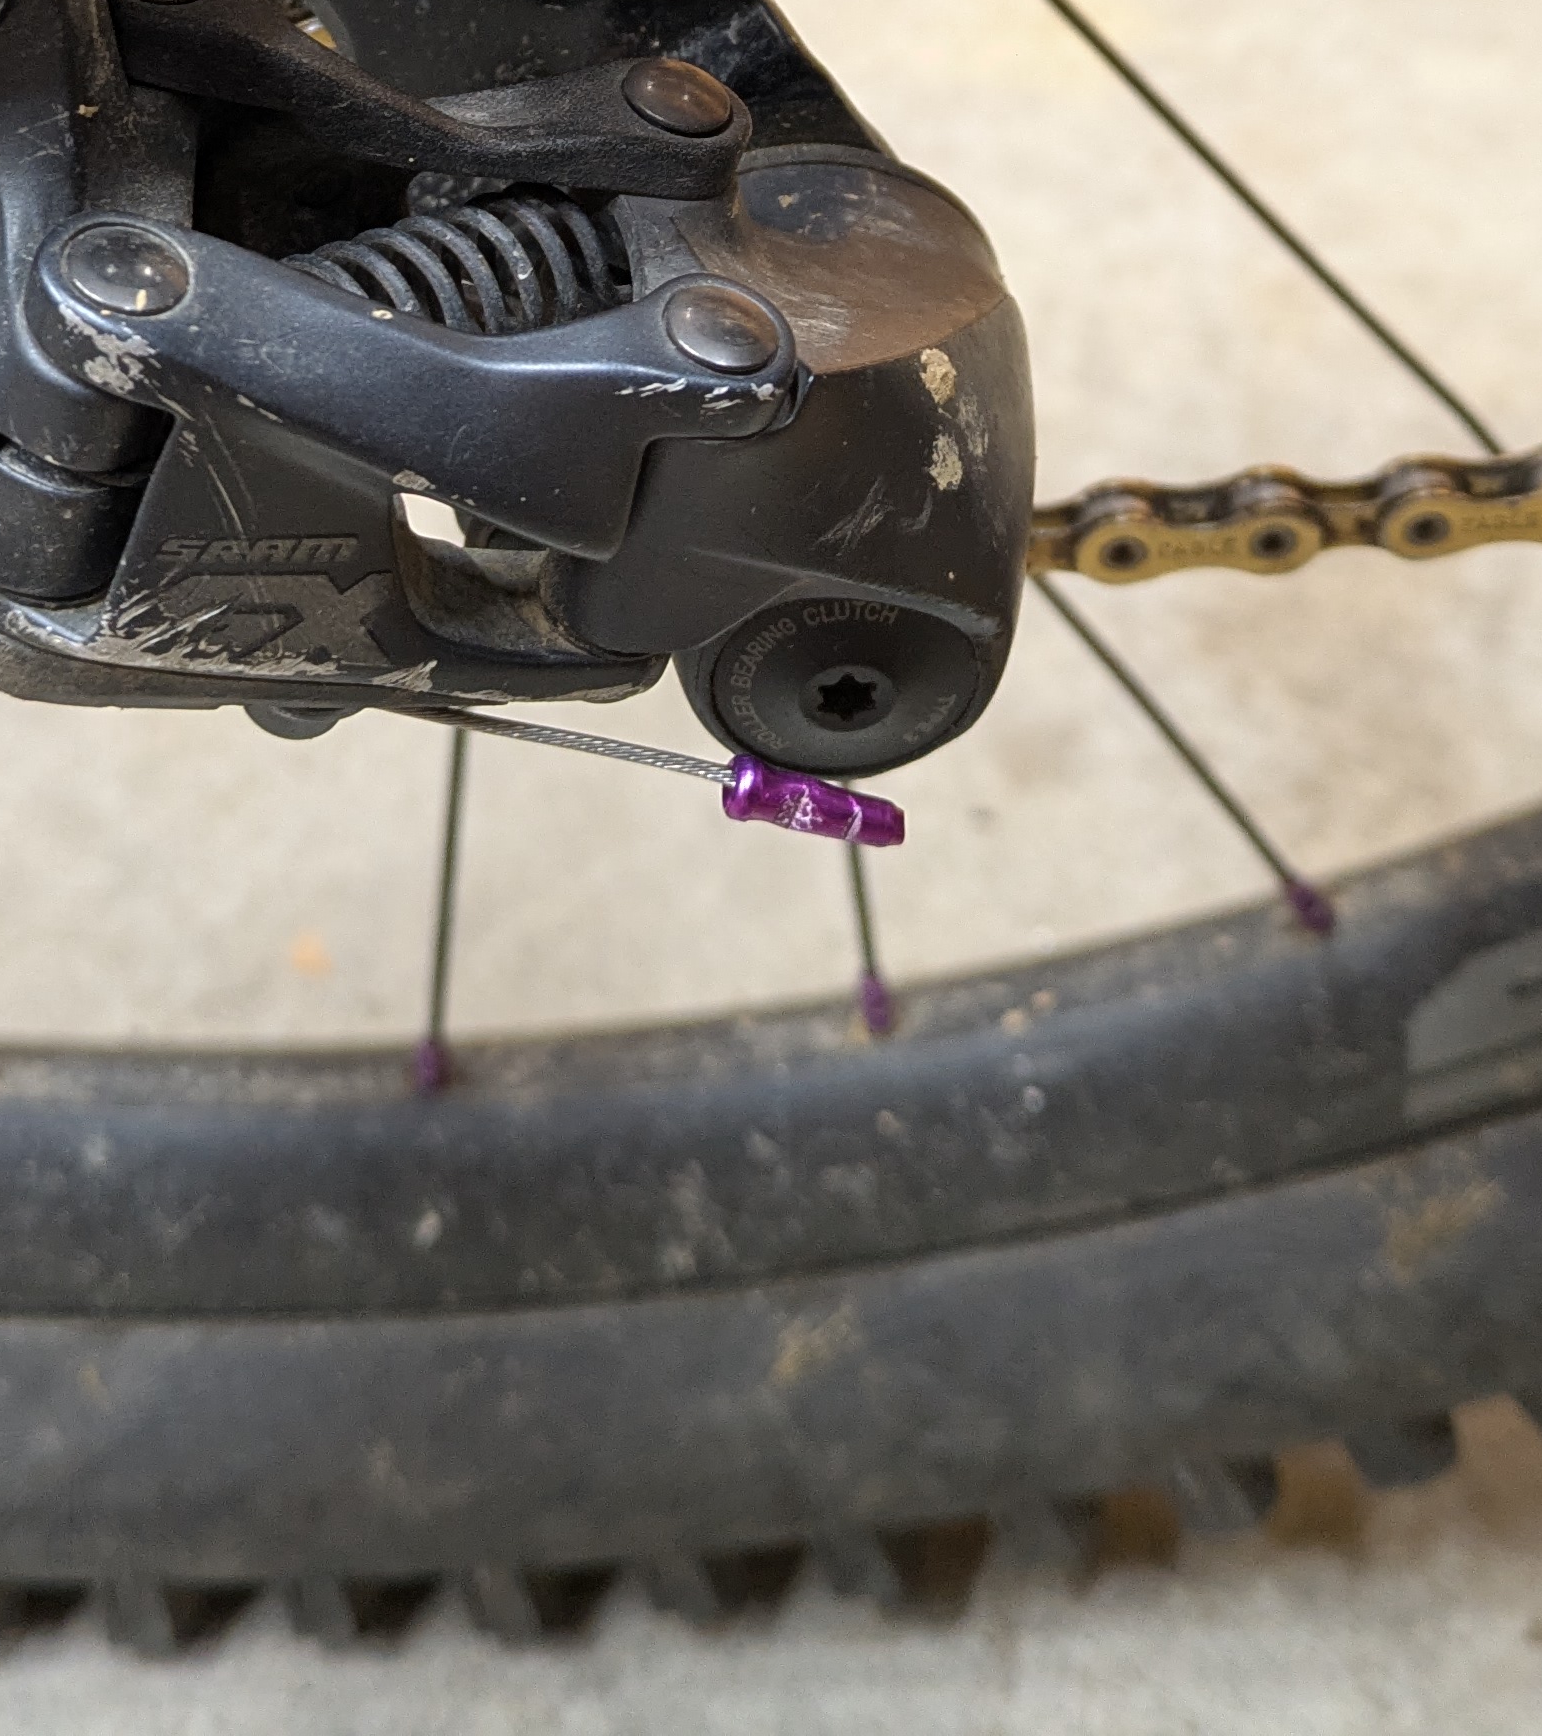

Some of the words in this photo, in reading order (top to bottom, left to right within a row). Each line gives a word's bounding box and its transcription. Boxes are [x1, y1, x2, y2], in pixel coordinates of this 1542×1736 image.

[157, 533, 360, 564] SRAM
[730, 617, 797, 689] BEARING
[802, 601, 900, 627] CLUTCH
